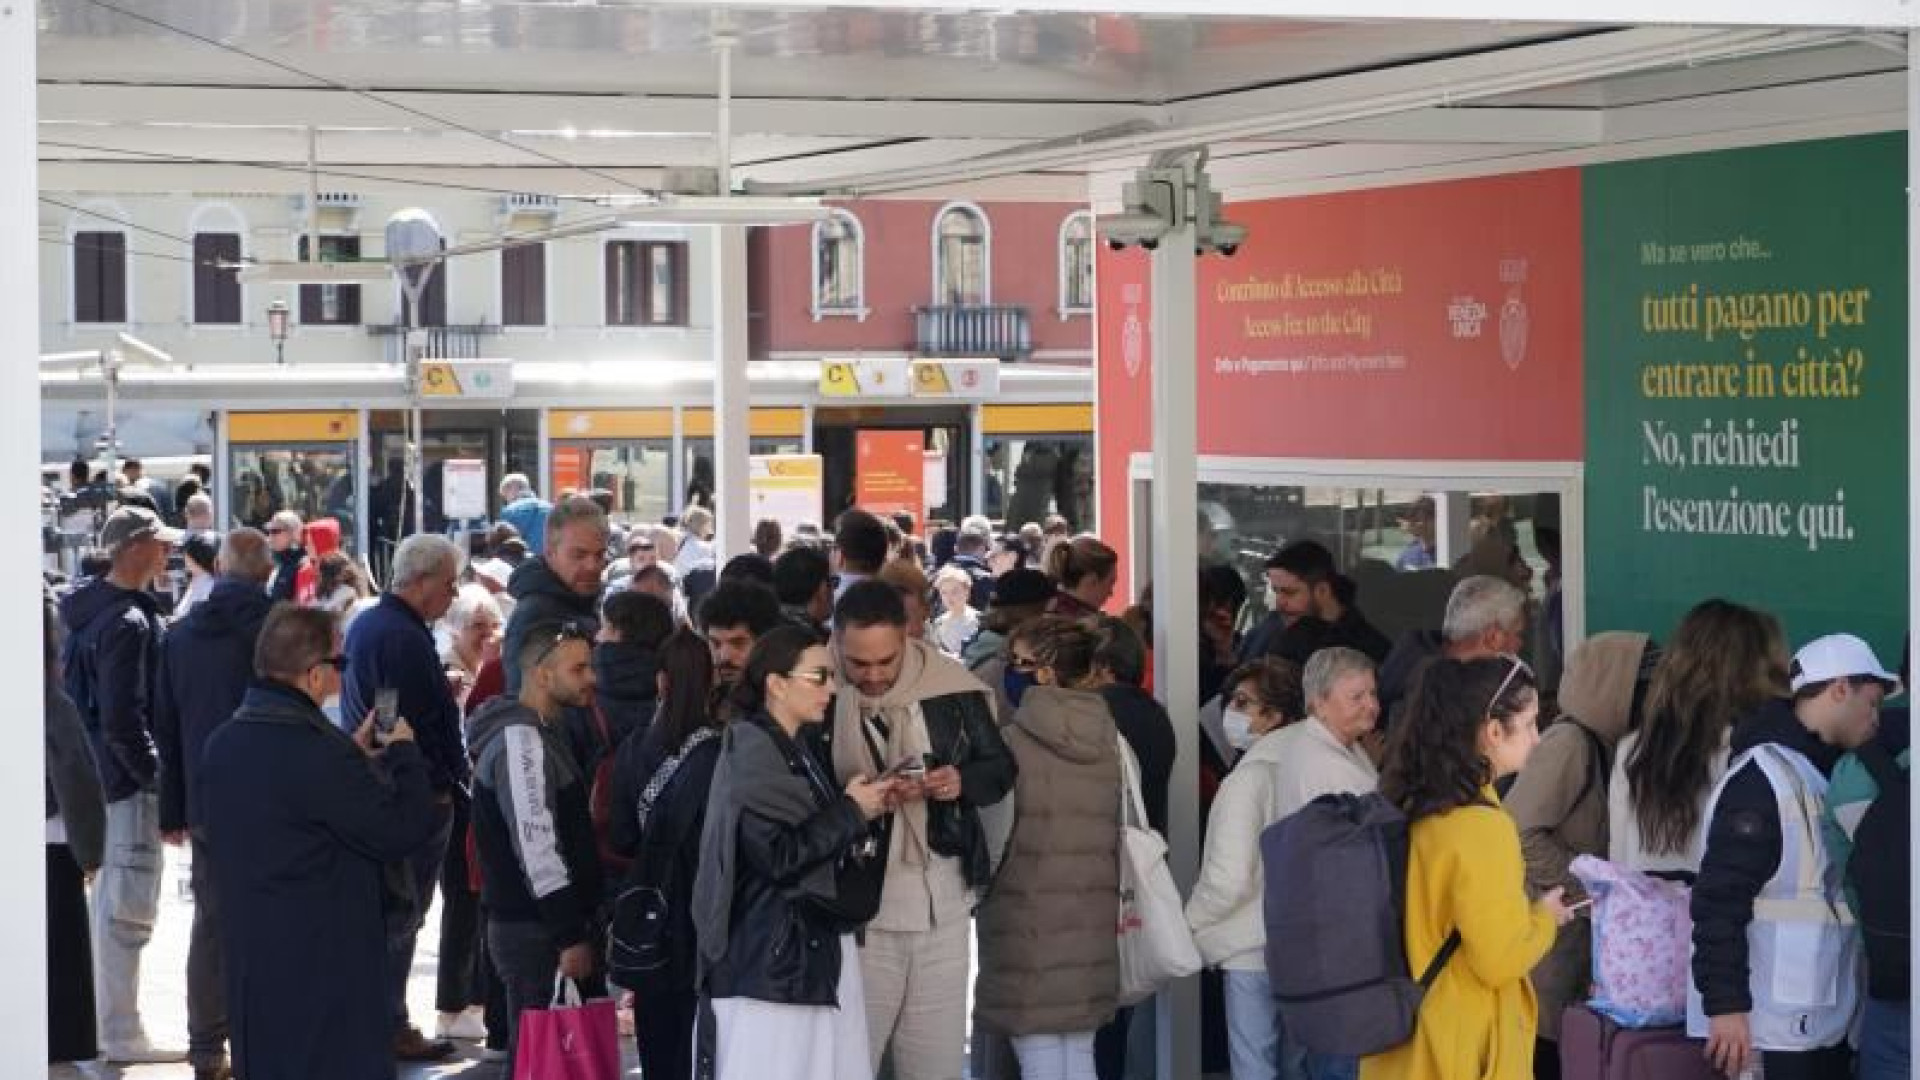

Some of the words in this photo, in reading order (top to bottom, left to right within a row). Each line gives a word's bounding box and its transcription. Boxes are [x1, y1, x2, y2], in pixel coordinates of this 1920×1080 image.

[1643, 284, 1698, 332] tutti
[1706, 291, 1811, 341] pagano
[1818, 287, 1871, 338] per
[427, 366, 444, 386] C
[828, 364, 843, 383] C
[918, 365, 935, 383] C
[1643, 359, 1740, 398] entrare
[1746, 348, 1774, 397] in
[1782, 347, 1864, 397] città?
[1642, 419, 1686, 472] No,
[1691, 418, 1799, 467] richiedi
[1642, 485, 1792, 537] l'esenzione
[1796, 488, 1854, 551] qui.
